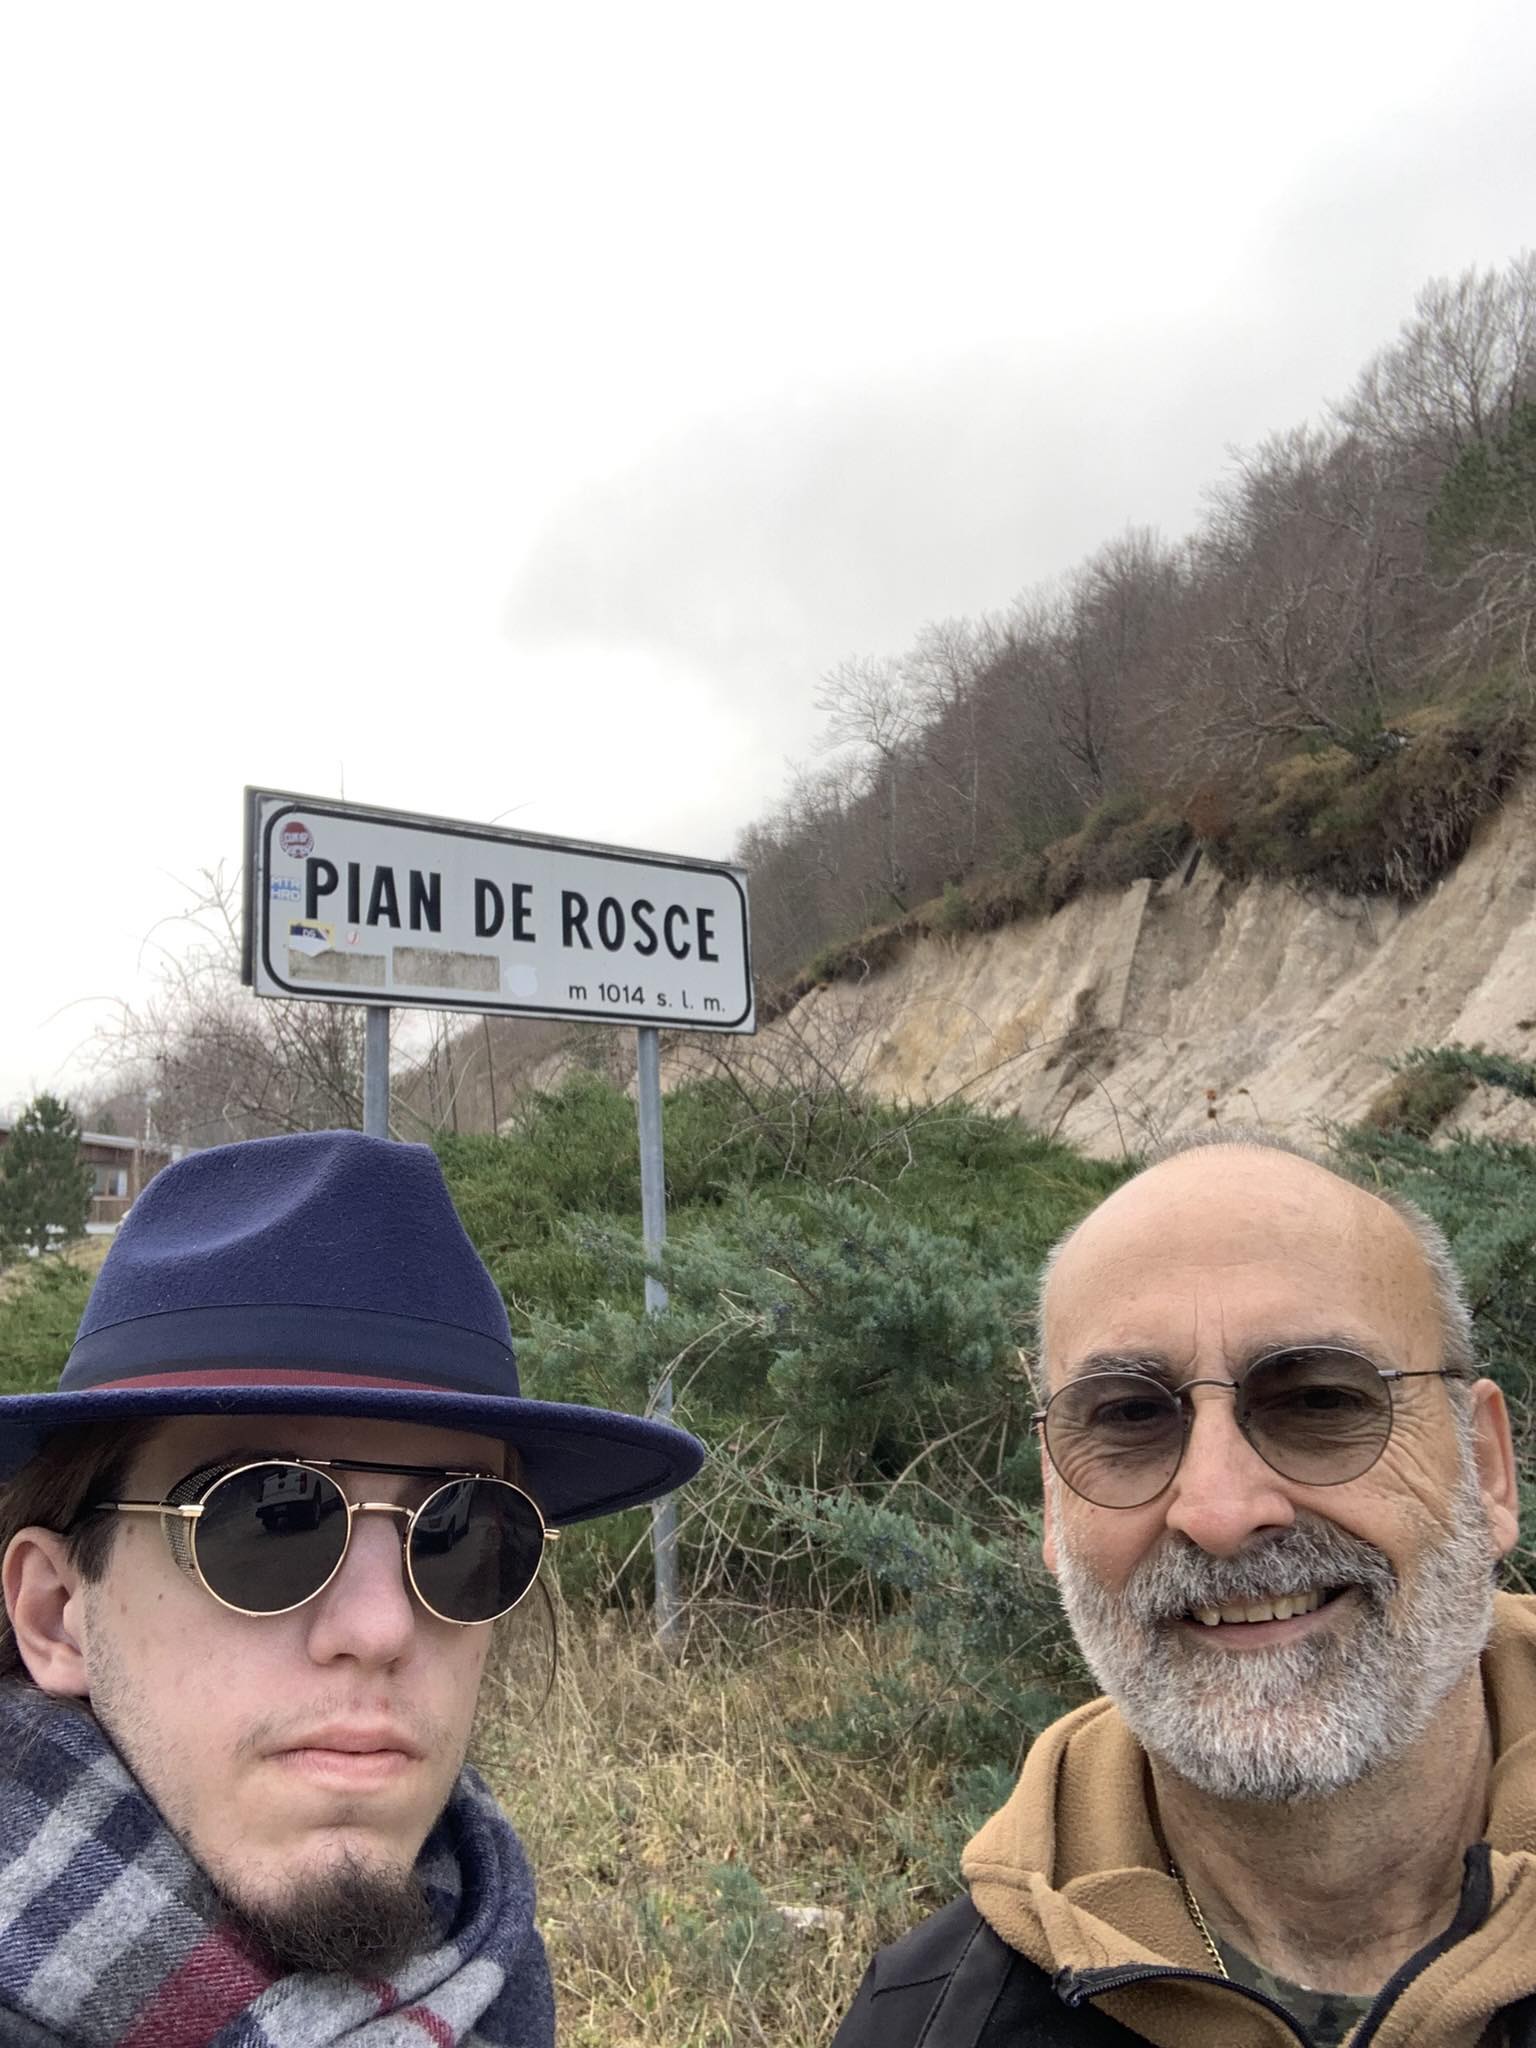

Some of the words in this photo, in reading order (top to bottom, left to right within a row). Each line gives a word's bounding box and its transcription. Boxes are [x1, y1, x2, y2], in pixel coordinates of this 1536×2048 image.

[305, 857, 442, 934] PIAN
[474, 878, 537, 943] DE
[561, 890, 720, 962] ROSCE
[568, 984, 588, 1000] m
[598, 982, 646, 1005] 1014
[656, 992, 673, 1008] s.
[703, 996, 726, 1013] m.
